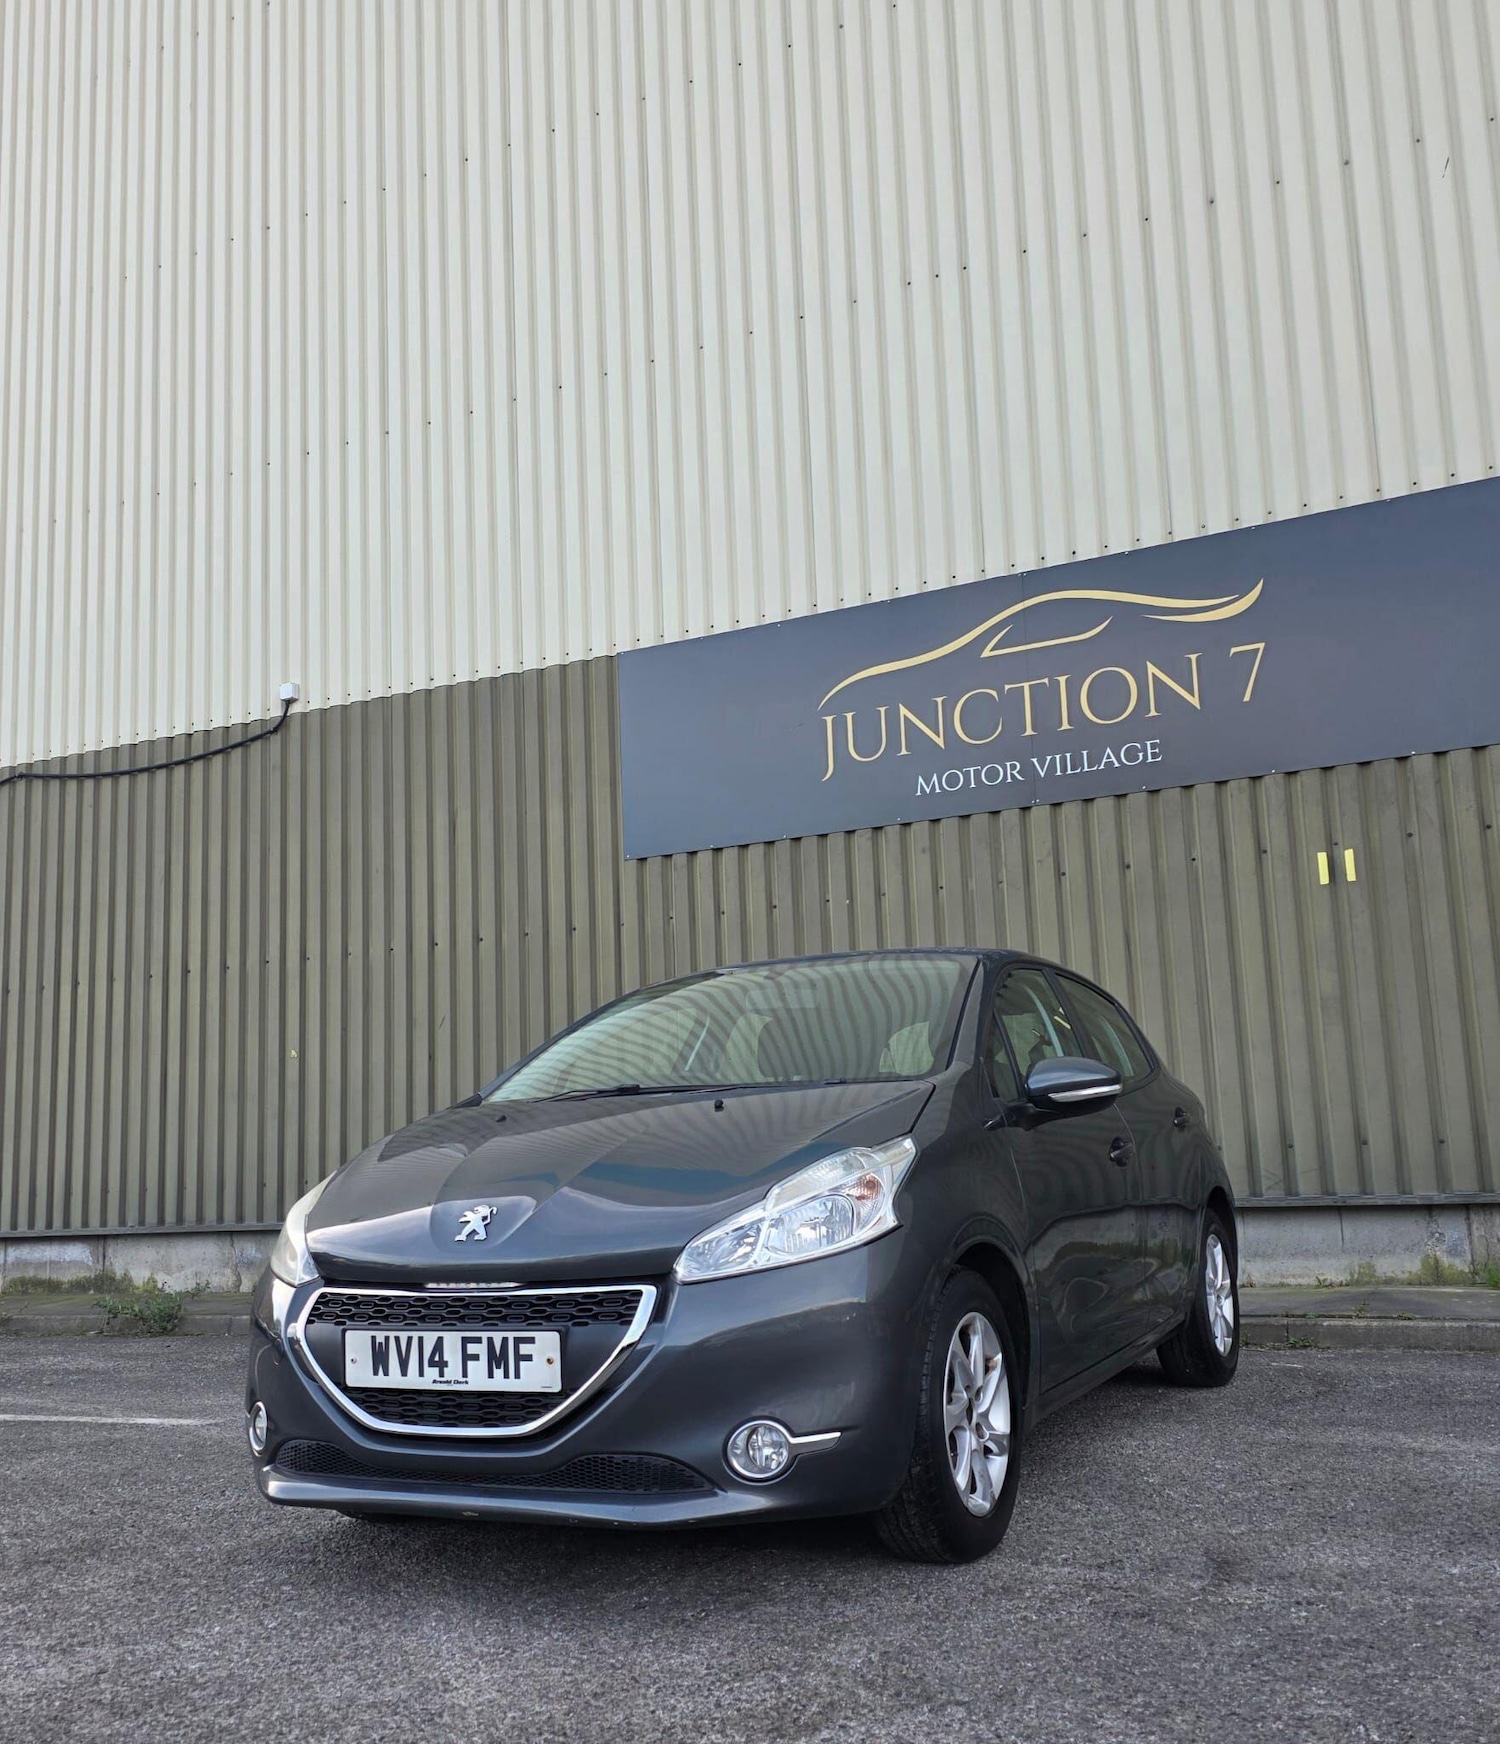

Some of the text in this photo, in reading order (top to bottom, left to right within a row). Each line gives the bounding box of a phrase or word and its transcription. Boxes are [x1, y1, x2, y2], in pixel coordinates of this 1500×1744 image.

[820, 642, 1266, 782] JUNCTION 7
[915, 739, 1162, 796] MOTOR VILLAGE
[370, 1335, 536, 1379] WV14 FMF
